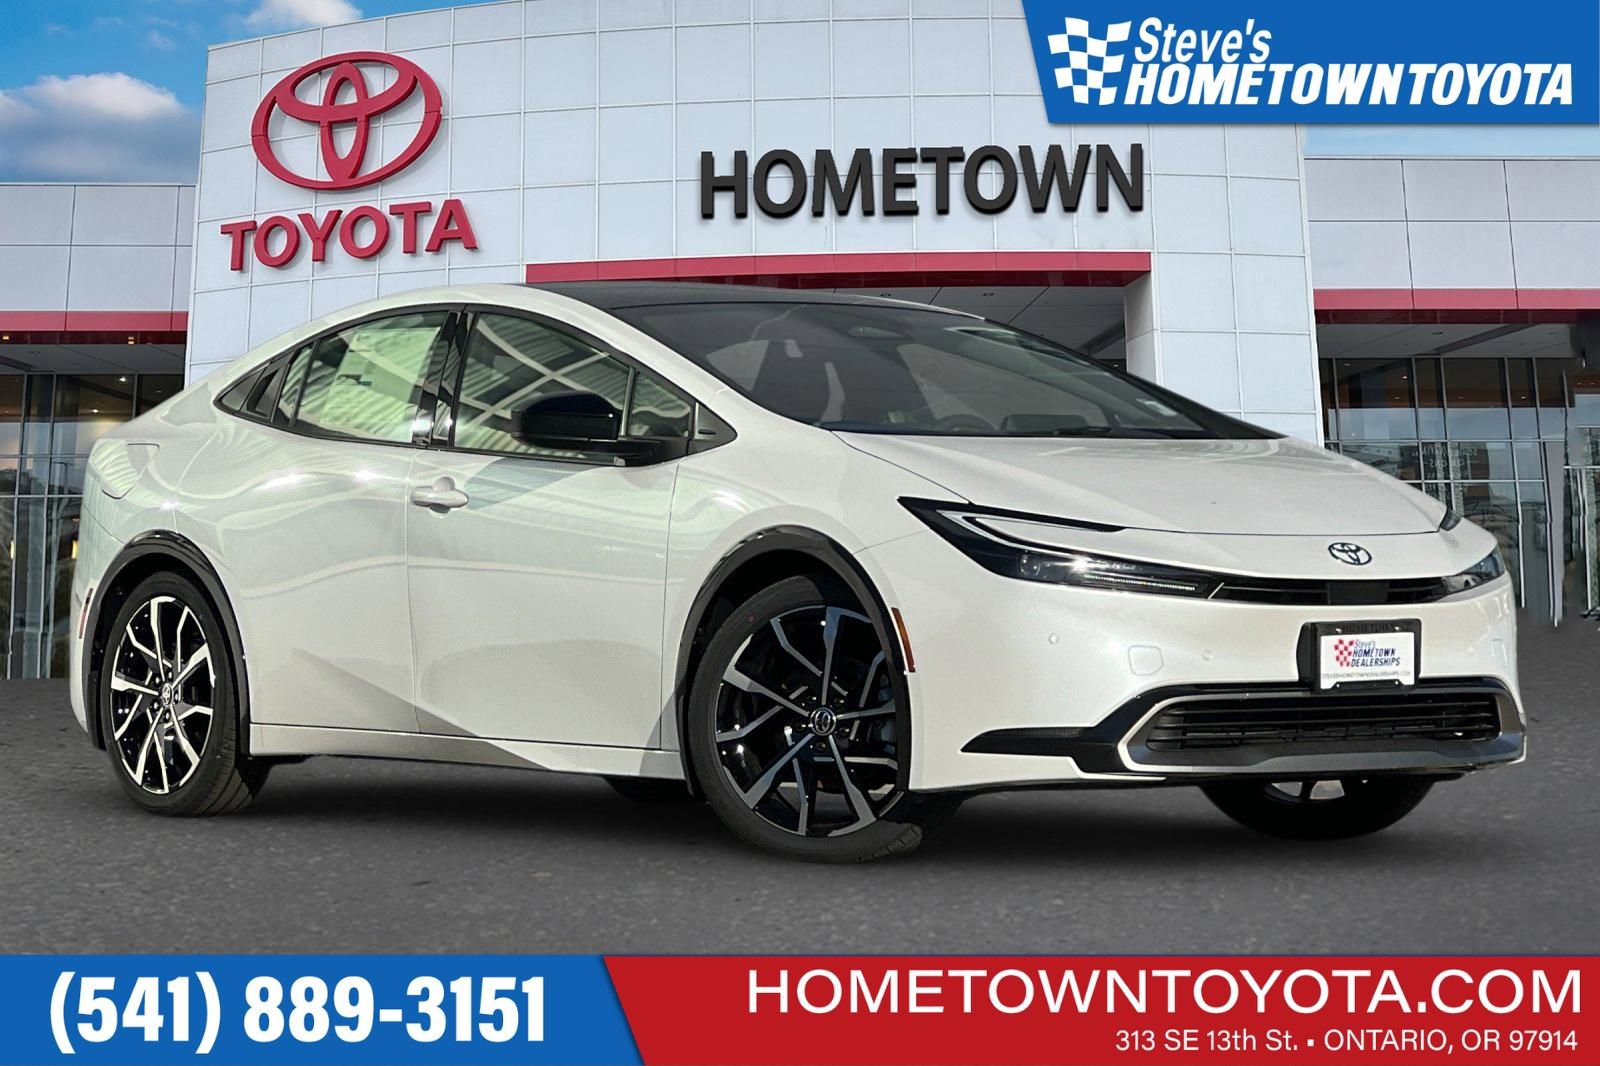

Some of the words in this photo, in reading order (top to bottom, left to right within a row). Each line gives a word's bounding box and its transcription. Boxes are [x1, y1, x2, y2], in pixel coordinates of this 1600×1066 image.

[700, 143, 1144, 219] HOMETOWN
[220, 198, 479, 271] TOYOTA
[1354, 639, 1377, 649] Steve's
[1352, 647, 1397, 658] HOMETOWN
[1350, 657, 1401, 667] DEALERSHIPS
